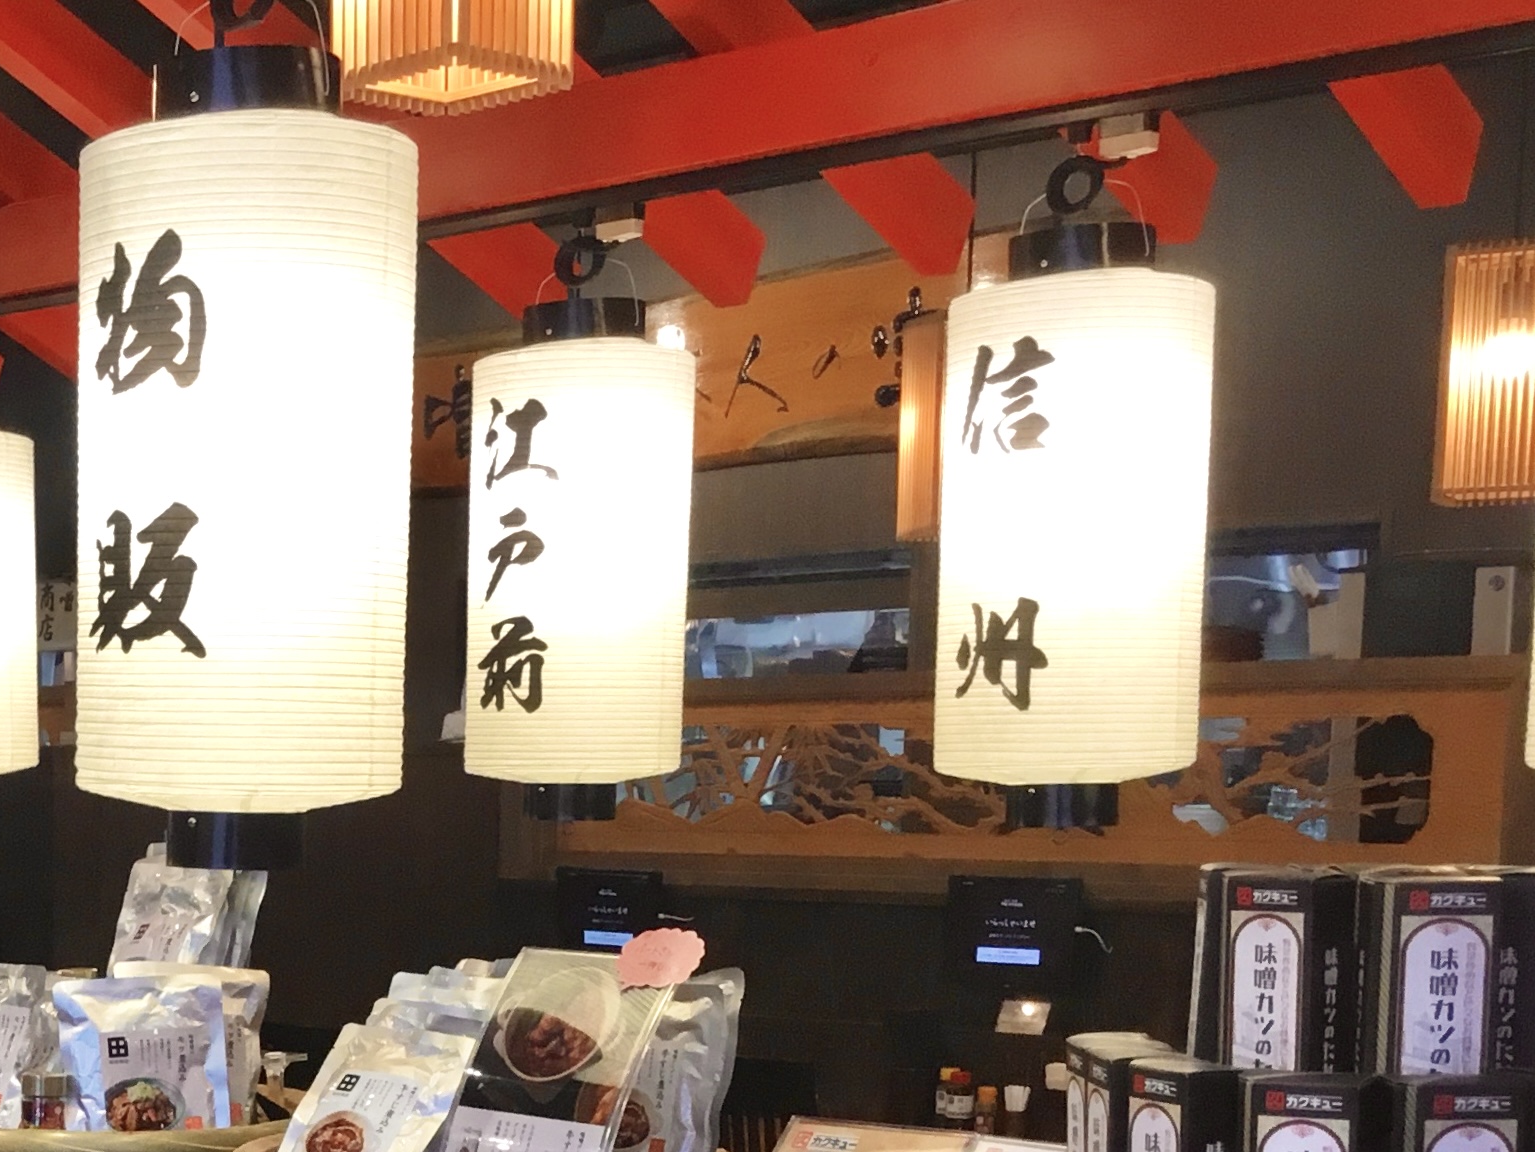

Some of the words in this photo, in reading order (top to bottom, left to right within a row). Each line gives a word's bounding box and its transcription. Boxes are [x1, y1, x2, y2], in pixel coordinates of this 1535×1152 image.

[90, 228, 207, 659] 物販
[955, 335, 1055, 711] 信州
[478, 397, 558, 714] 江戸前
[1252, 889, 1298, 905] カクキュー
[1430, 892, 1487, 908] カクキュー
[1144, 1079, 1177, 1097] カクキュー
[1286, 1095, 1343, 1112] カクキュー
[1454, 1097, 1510, 1112] カクキュー
[813, 1133, 858, 1150] カクキュー
